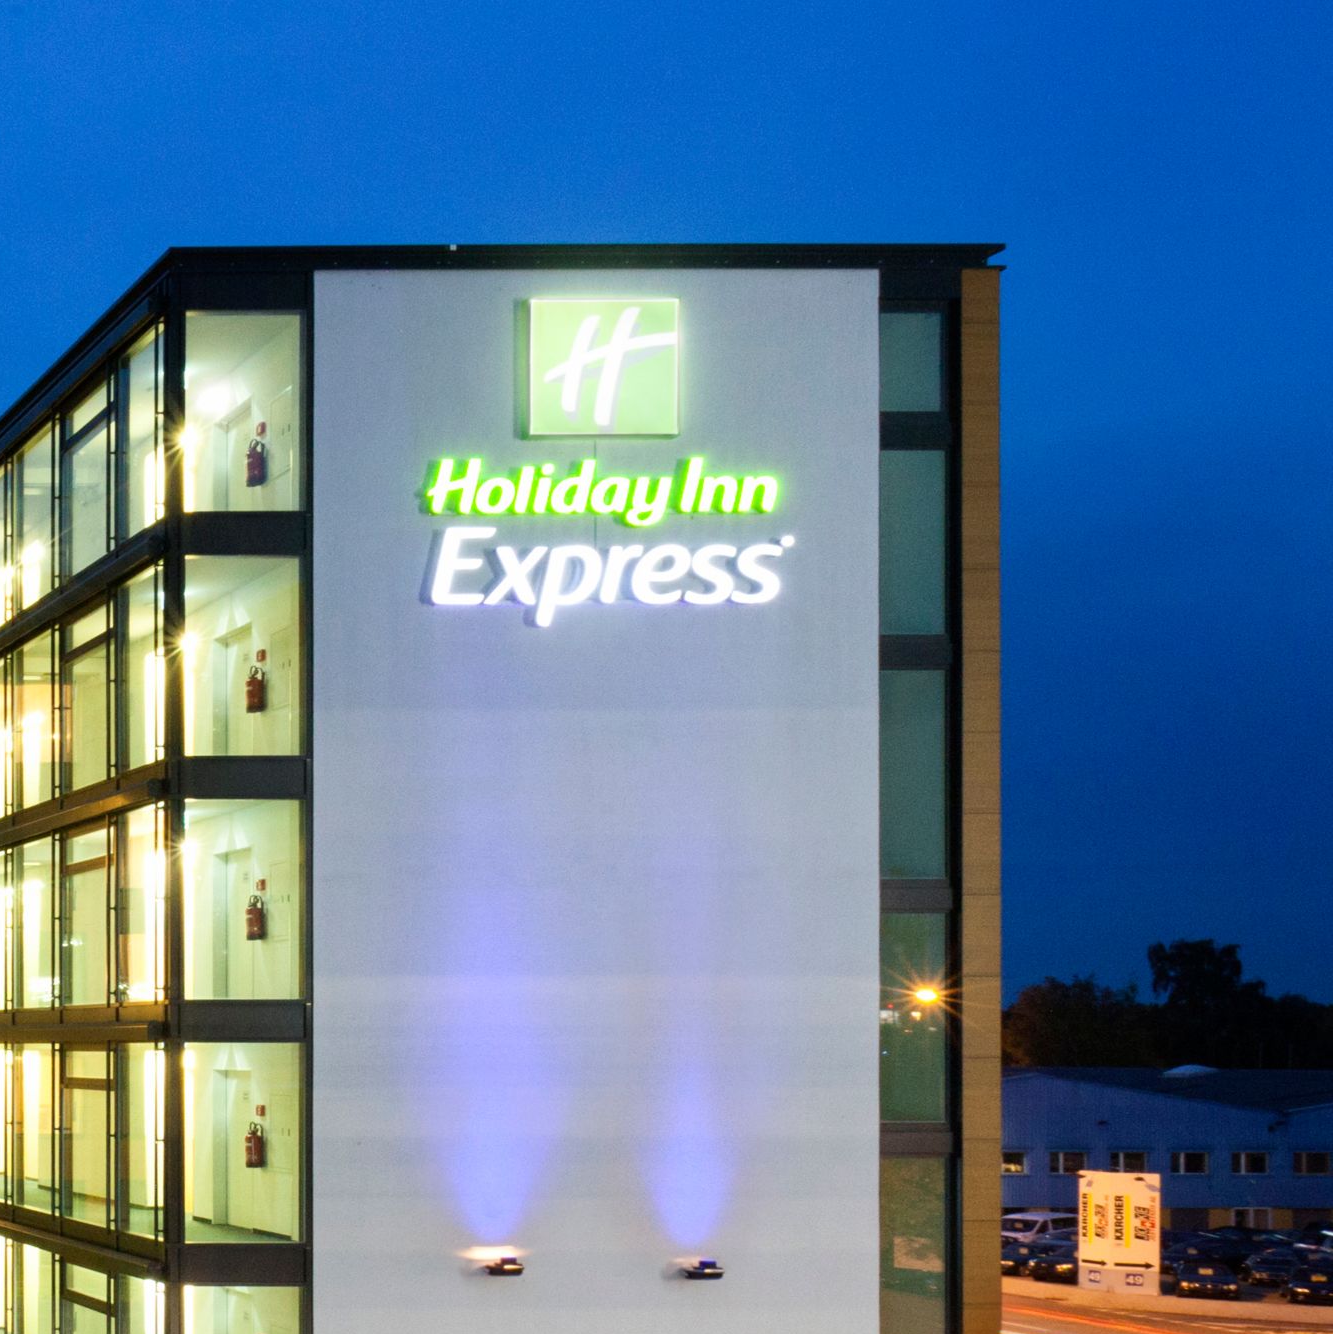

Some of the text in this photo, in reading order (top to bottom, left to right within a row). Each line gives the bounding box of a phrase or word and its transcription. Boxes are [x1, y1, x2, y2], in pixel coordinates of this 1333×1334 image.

[427, 455, 778, 527] Holiday Inn
[430, 526, 783, 628] Express
